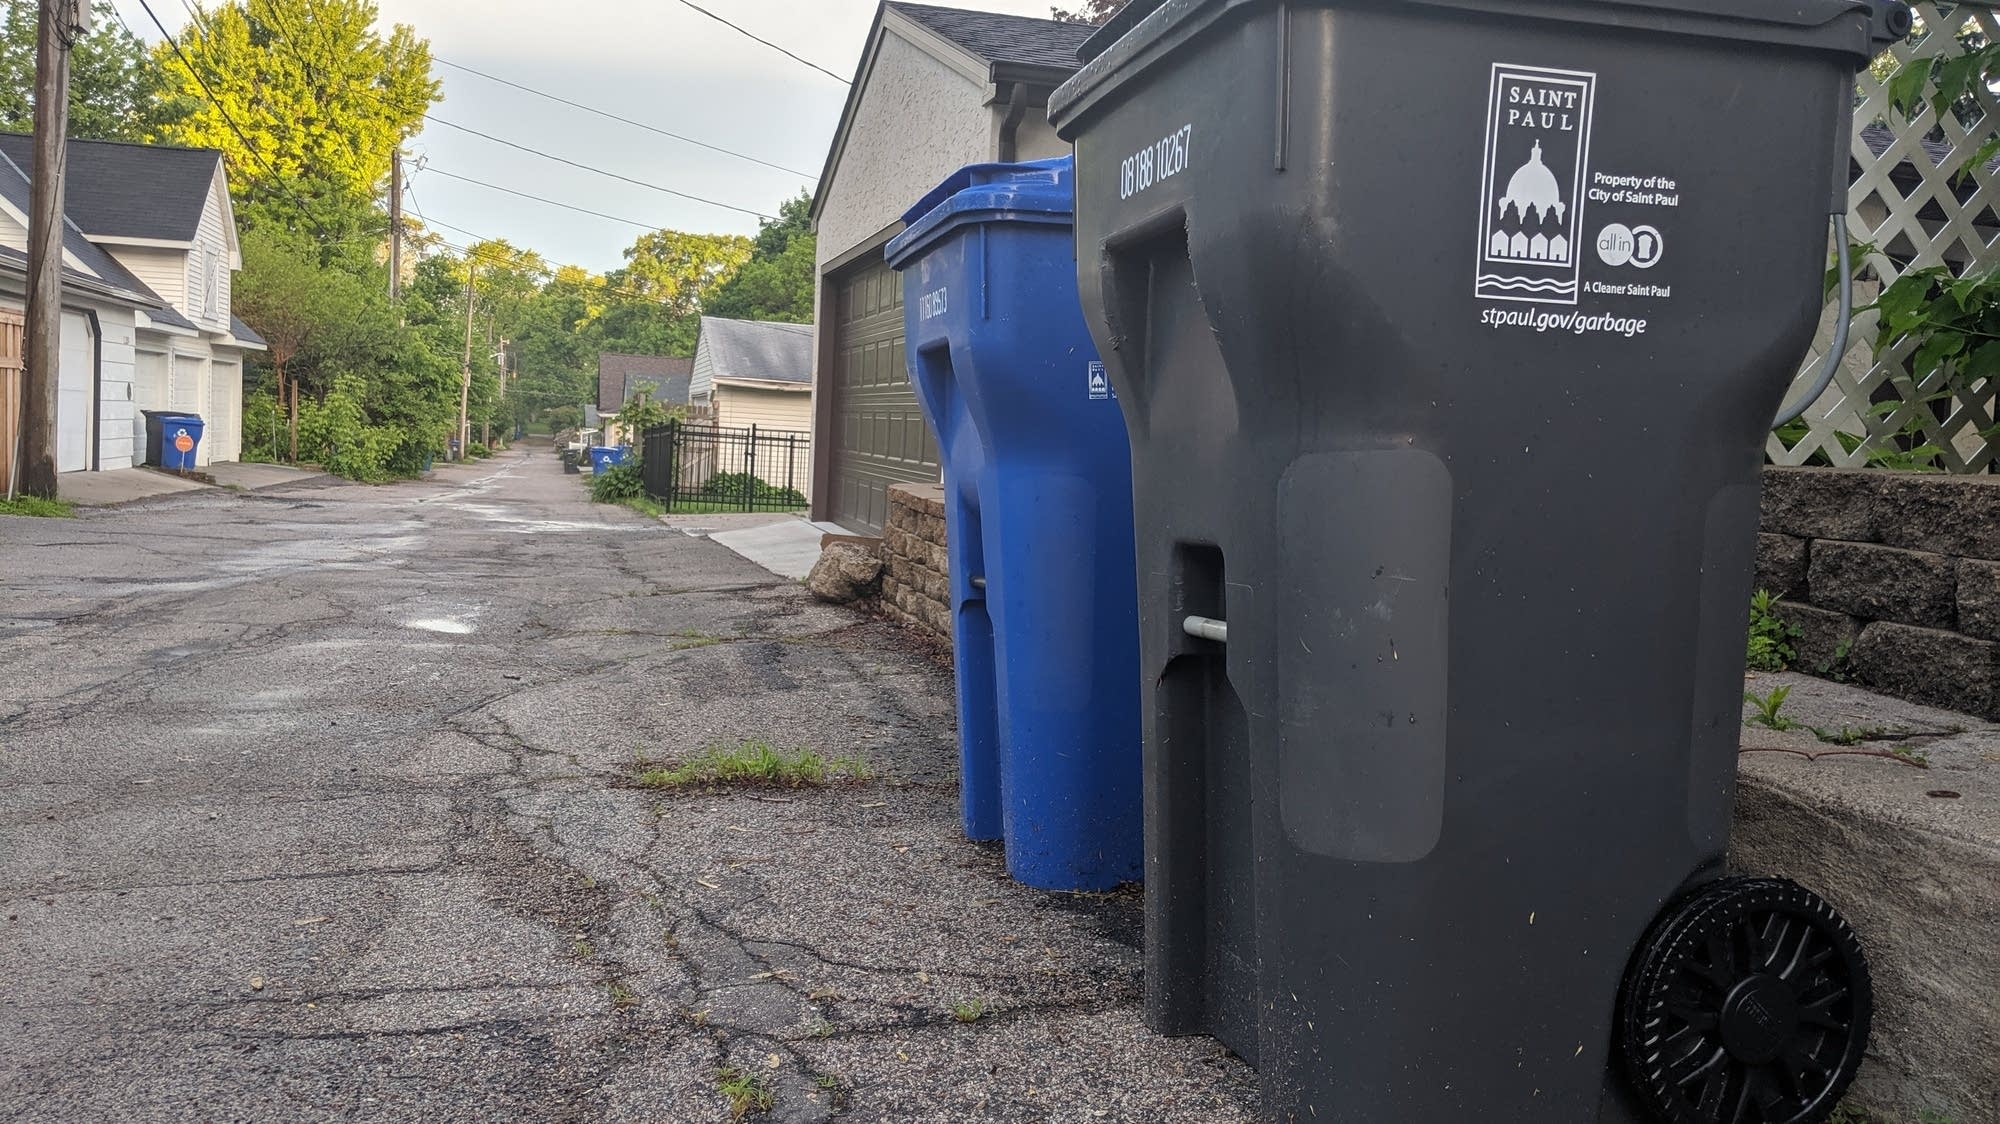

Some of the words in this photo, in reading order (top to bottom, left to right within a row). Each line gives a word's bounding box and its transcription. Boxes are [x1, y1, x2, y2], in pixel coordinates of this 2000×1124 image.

[1509, 86, 1577, 109] SAINT
[1508, 109, 1573, 131] PAUL
[1121, 146, 1153, 200] 08188
[1156, 123, 1192, 183] 10267
[1594, 172, 1642, 190] Property
[1643, 176, 1656, 189] of
[1657, 177, 1676, 190] the
[1588, 188, 1611, 204] City
[1612, 190, 1625, 202] of
[1625, 191, 1653, 204] Saint
[1655, 193, 1679, 206] Paul
[1599, 233, 1617, 251] all
[1619, 236, 1631, 251] in
[1583, 281, 1591, 292] A
[1592, 282, 1626, 295] Cleaner
[1627, 284, 1650, 296] Saint
[1651, 285, 1671, 297] Paul
[1480, 307, 1647, 338] stpaul.gov/garbage
